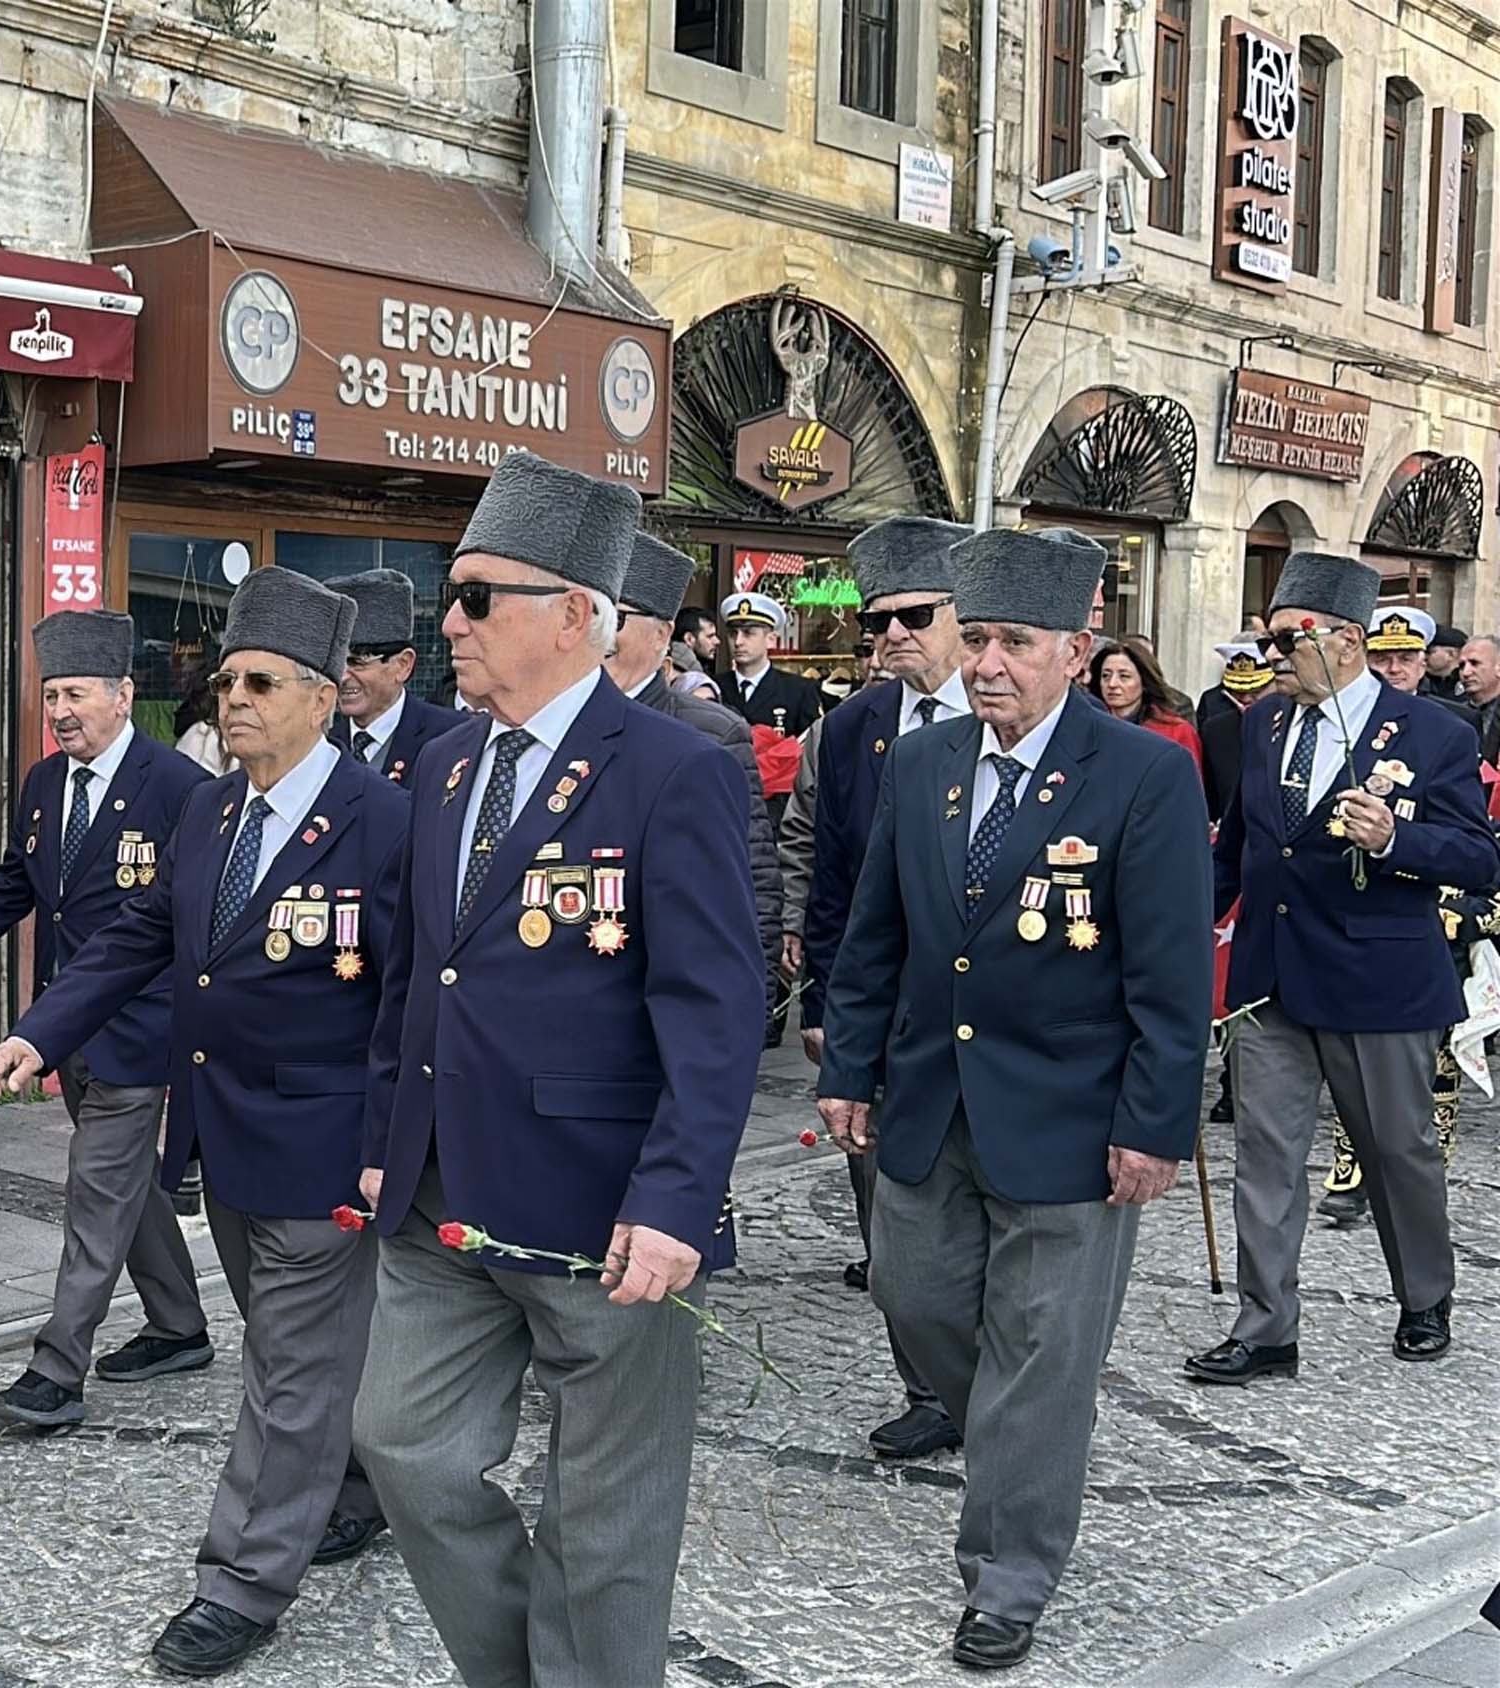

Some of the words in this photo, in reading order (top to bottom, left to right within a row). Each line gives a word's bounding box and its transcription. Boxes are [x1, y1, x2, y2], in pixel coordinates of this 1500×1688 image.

[1242, 147, 1293, 196] pilates
[1242, 199, 1291, 245] studio
[17, 335, 67, 356] şenpiliç
[233, 305, 290, 359] CP
[381, 298, 532, 369] EFSANE
[339, 354, 389, 408] 33
[401, 362, 567, 432] TANTUNİ
[611, 366, 650, 413] CP
[232, 403, 290, 444] PİLİÇ
[1235, 388, 1288, 430] TEKİN
[1293, 408, 1369, 446] HELVACISI
[385, 429, 425, 460] Tel:
[432, 435, 469, 464] 214
[475, 440, 500, 467] 40
[606, 448, 650, 483] PİLİÇ
[769, 446, 822, 469] SAVALA
[1229, 433, 1279, 463] MEŞHUR
[52, 538, 96, 552] EFSANE
[51, 564, 97, 602] 33
